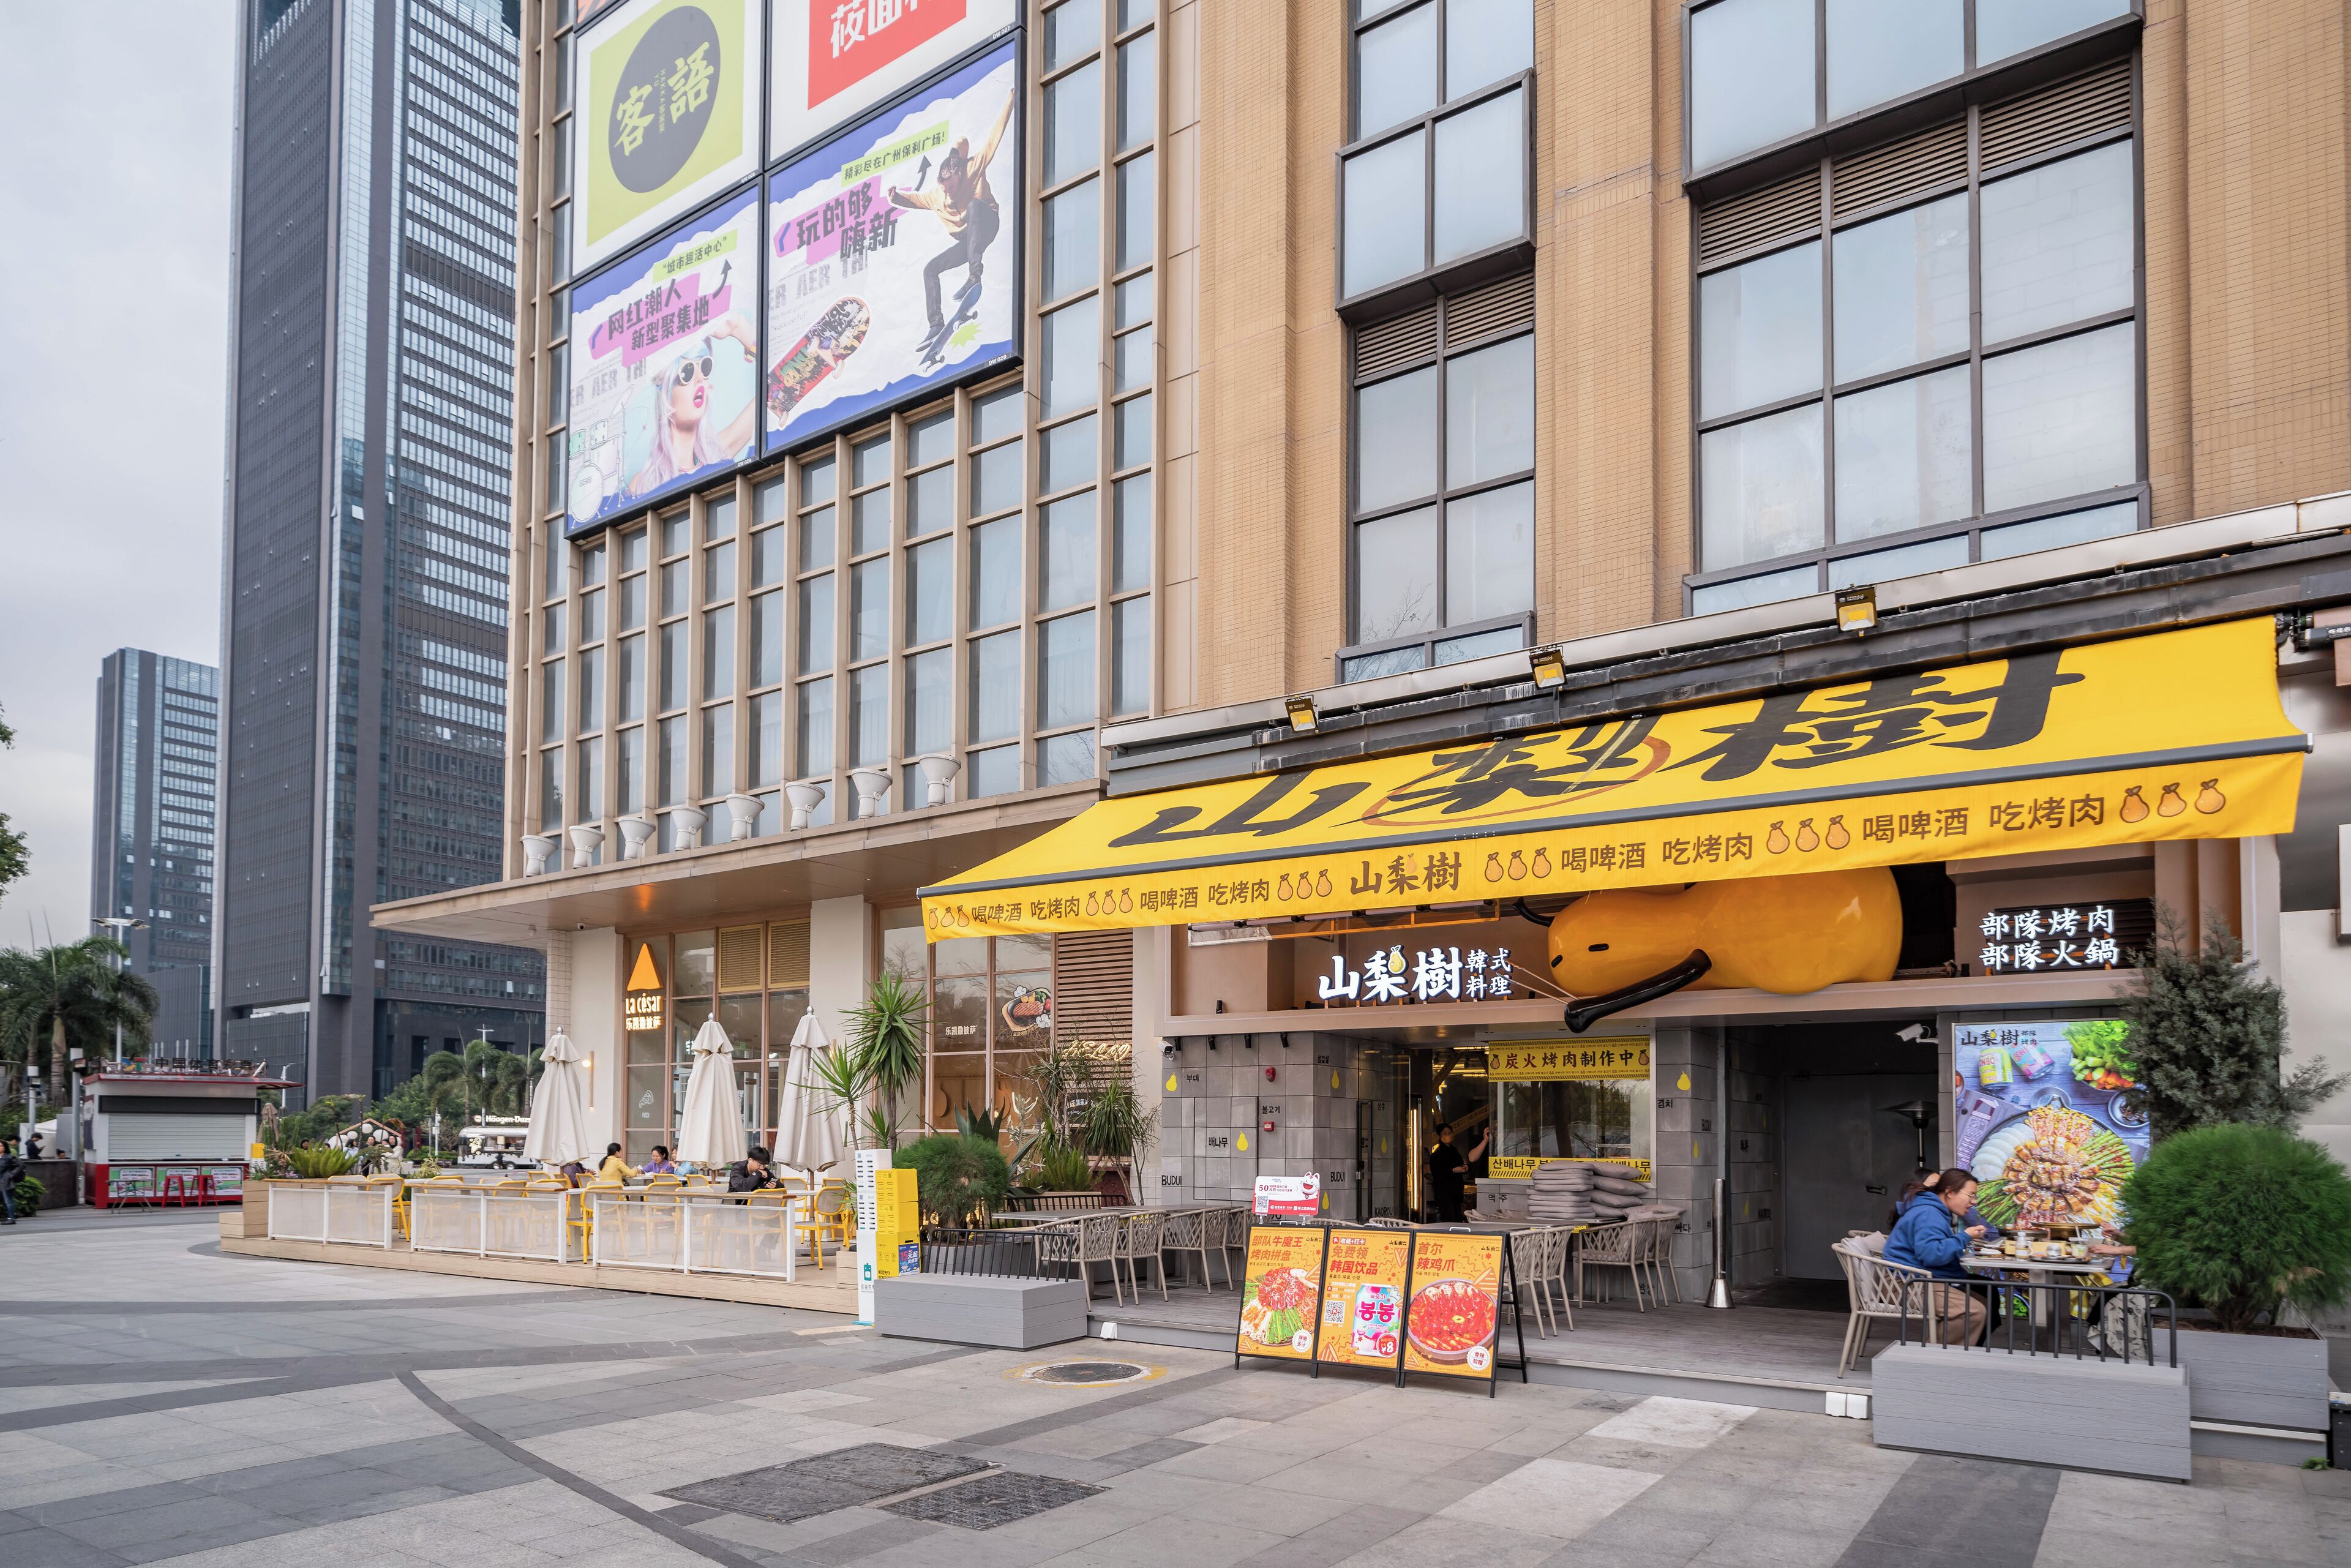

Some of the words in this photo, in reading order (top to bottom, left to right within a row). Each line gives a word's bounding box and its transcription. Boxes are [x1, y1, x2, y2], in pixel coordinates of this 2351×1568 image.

[844, 132, 945, 180] 精彩尽在广州保利广场!
[797, 182, 872, 250] 玩的够
[840, 206, 898, 259] 嗨新
[609, 278, 681, 340] 网红潮人
[631, 295, 709, 350] 新型聚集地
[1108, 648, 2086, 848] 山梨樹
[972, 902, 1021, 923] 喝啤酒
[1030, 896, 1080, 920] 吃烤肉
[1140, 886, 1198, 912] 喝啤酒
[1209, 878, 1269, 907] 吃烤肉
[1350, 851, 1462, 896] 山梨樹
[1561, 841, 1646, 873] 喝啤酒
[1662, 832, 1753, 866] 吃烤肉
[1863, 807, 1968, 844] 喝啤酒
[1989, 793, 2105, 831] 吃烤肉
[1979, 905, 2115, 941] 部隊烤肉
[1465, 947, 1513, 974] 韓式
[1979, 937, 2120, 971] 部隊火鍋
[1318, 946, 1464, 1002] 山梨樹
[1466, 974, 1513, 999] 料理
[945, 1026, 977, 1035] 乐凯撒披萨
[1961, 1029, 2019, 1046] 山梨樹
[1504, 1049, 1633, 1070] 炭火烤肉制作中
[1187, 1074, 1199, 1082] 부대
[1209, 1136, 1228, 1148] 배나무
[1492, 1158, 1536, 1170] 산배나무
[1161, 1175, 1182, 1186] BUDUI
[1330, 1172, 1346, 1182] BUDUI
[1374, 1207, 1393, 1217] KAOROU
[1251, 1235, 1303, 1248] 部队牛魔王
[1417, 1242, 1444, 1256] 首尔
[1250, 1249, 1292, 1261] 烤肉拼盘
[1331, 1245, 1369, 1259] 免费领
[1329, 1259, 1379, 1275] 韩国饮品
[1416, 1257, 1456, 1272] 辣鸡爪
[1359, 1301, 1395, 1323] 봉봉
